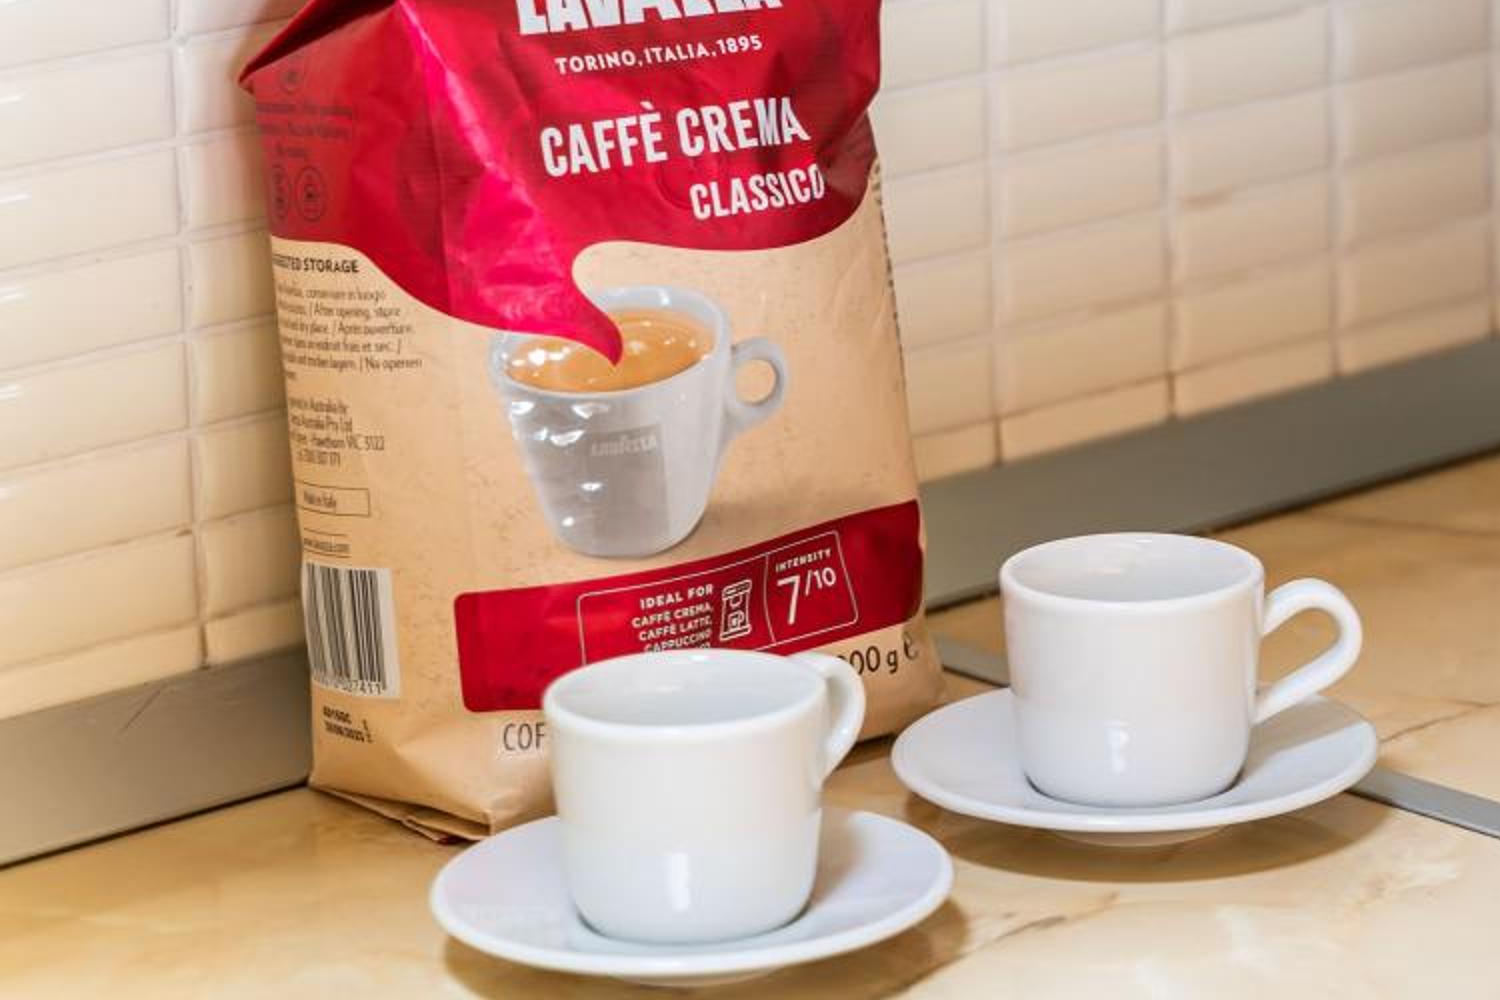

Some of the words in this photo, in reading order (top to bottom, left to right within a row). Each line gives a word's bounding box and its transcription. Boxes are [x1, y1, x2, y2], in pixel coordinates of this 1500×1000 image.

[716, 34, 763, 55] 1895
[540, 101, 669, 178] CAFFÈ
[676, 96, 812, 158] CREMA
[689, 163, 826, 220] CLASSICO
[303, 256, 360, 273] STORAGE
[775, 548, 832, 573] INTENSITY
[640, 591, 684, 611] IDEAL
[687, 583, 714, 600] FOR
[836, 645, 880, 675] 00
